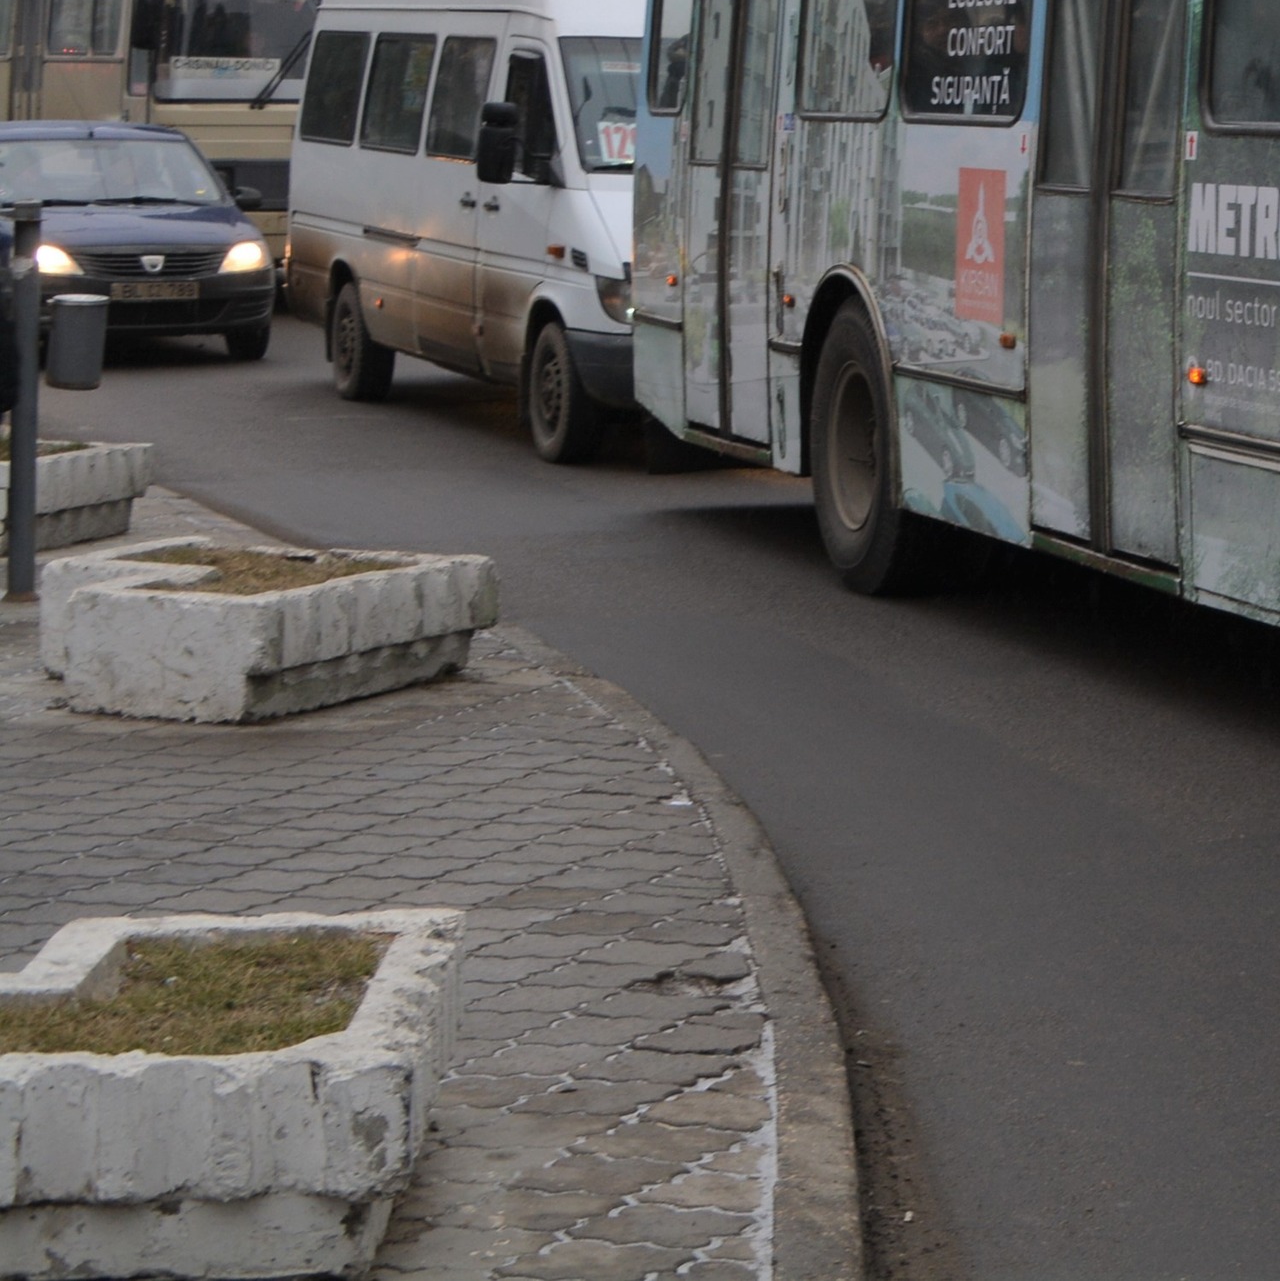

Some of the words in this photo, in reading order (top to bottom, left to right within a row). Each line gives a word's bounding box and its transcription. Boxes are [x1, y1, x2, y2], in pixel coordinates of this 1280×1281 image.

[947, 25, 1015, 56] CONFORT
[1186, 290, 1220, 321] noul
[1225, 296, 1277, 328] sector
[1206, 359, 1226, 383] BD.
[1228, 363, 1266, 392] DACIA
